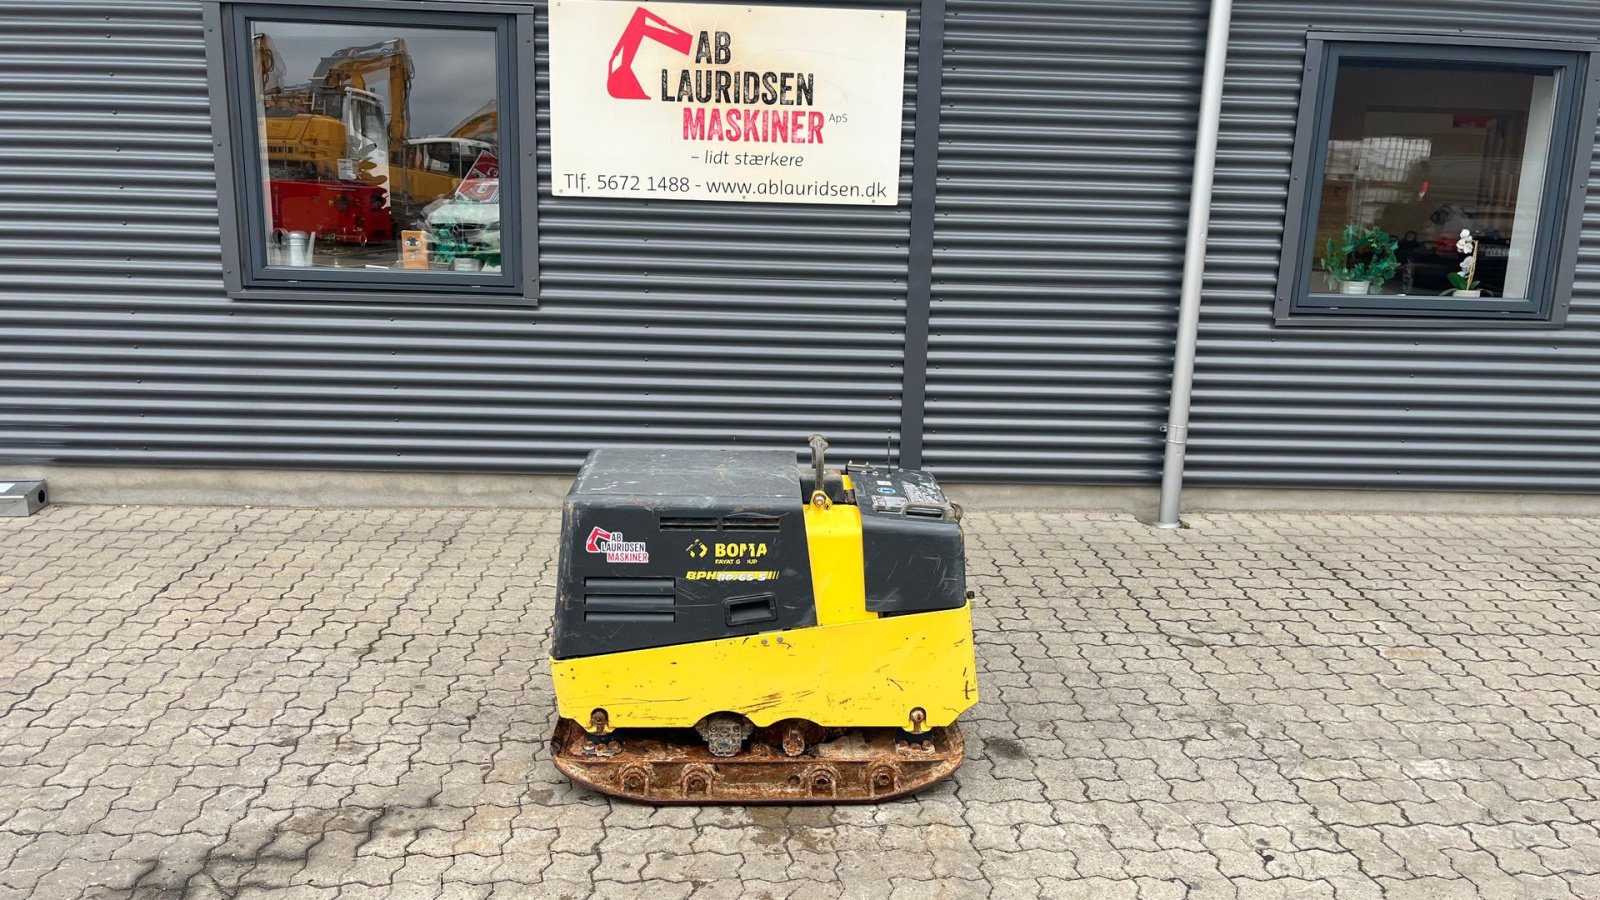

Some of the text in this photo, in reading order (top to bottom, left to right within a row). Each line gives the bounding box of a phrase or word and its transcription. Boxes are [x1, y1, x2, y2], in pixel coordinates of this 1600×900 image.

[695, 31, 731, 65] AB
[661, 69, 814, 106] LAURIDSEN
[683, 107, 848, 144] MASKINER ApS
[704, 150, 729, 165] lidt
[734, 152, 804, 167] stærkere
[564, 173, 591, 193] Tlf.
[597, 174, 640, 191] 5672
[647, 176, 690, 192] 1488
[706, 179, 887, 198] www.ablauridsen.dk
[601, 542, 645, 552] LAURIDSEN
[611, 532, 622, 542] AB
[607, 552, 648, 562] MASKINER
